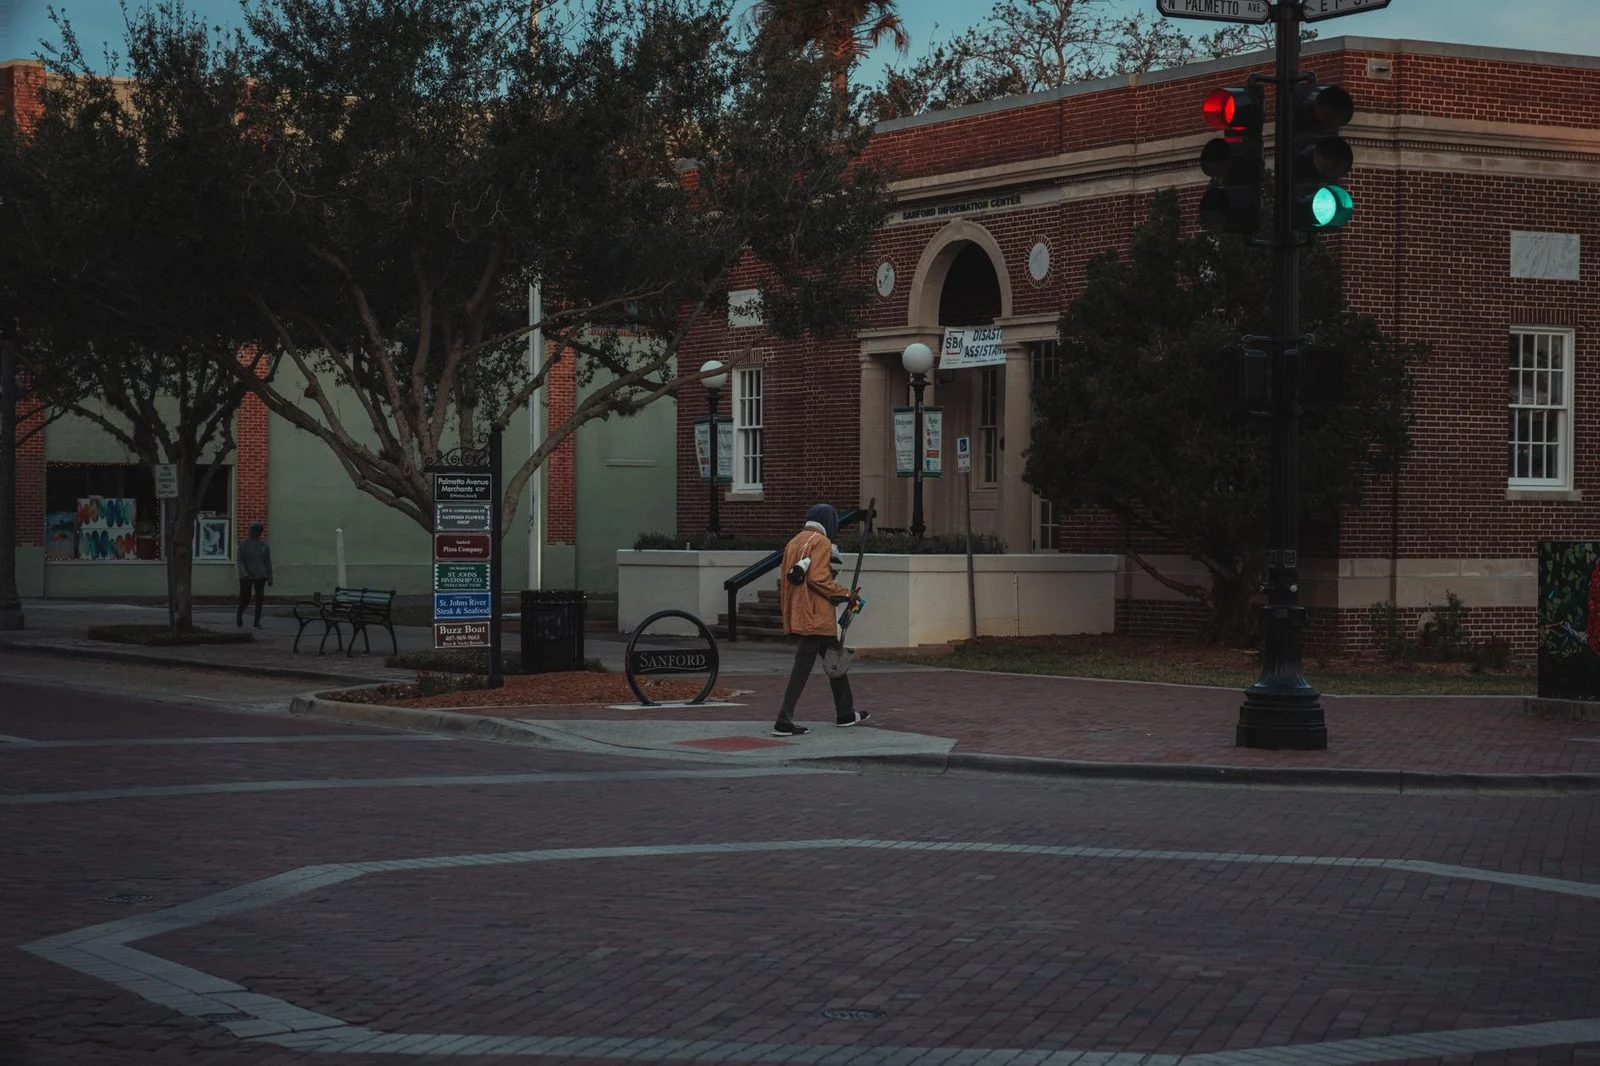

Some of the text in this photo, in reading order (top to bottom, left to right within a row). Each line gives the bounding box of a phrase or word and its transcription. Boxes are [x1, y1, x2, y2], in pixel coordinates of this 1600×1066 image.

[1186, 0, 1239, 15] PALMETTO
[1247, 2, 1261, 13] AVE
[903, 195, 1021, 220] SANFORD INFORMATION CENTER
[972, 328, 1003, 342] DISAST
[437, 477, 465, 485] Palmetto
[440, 485, 473, 493] Merchants
[458, 546, 483, 554] Company
[449, 599, 468, 607] Johns
[469, 598, 486, 606] River
[436, 607, 454, 615] Steak
[463, 606, 490, 614] Seafood
[439, 625, 486, 634] Buzz Boat
[640, 652, 706, 667] SANFORD
